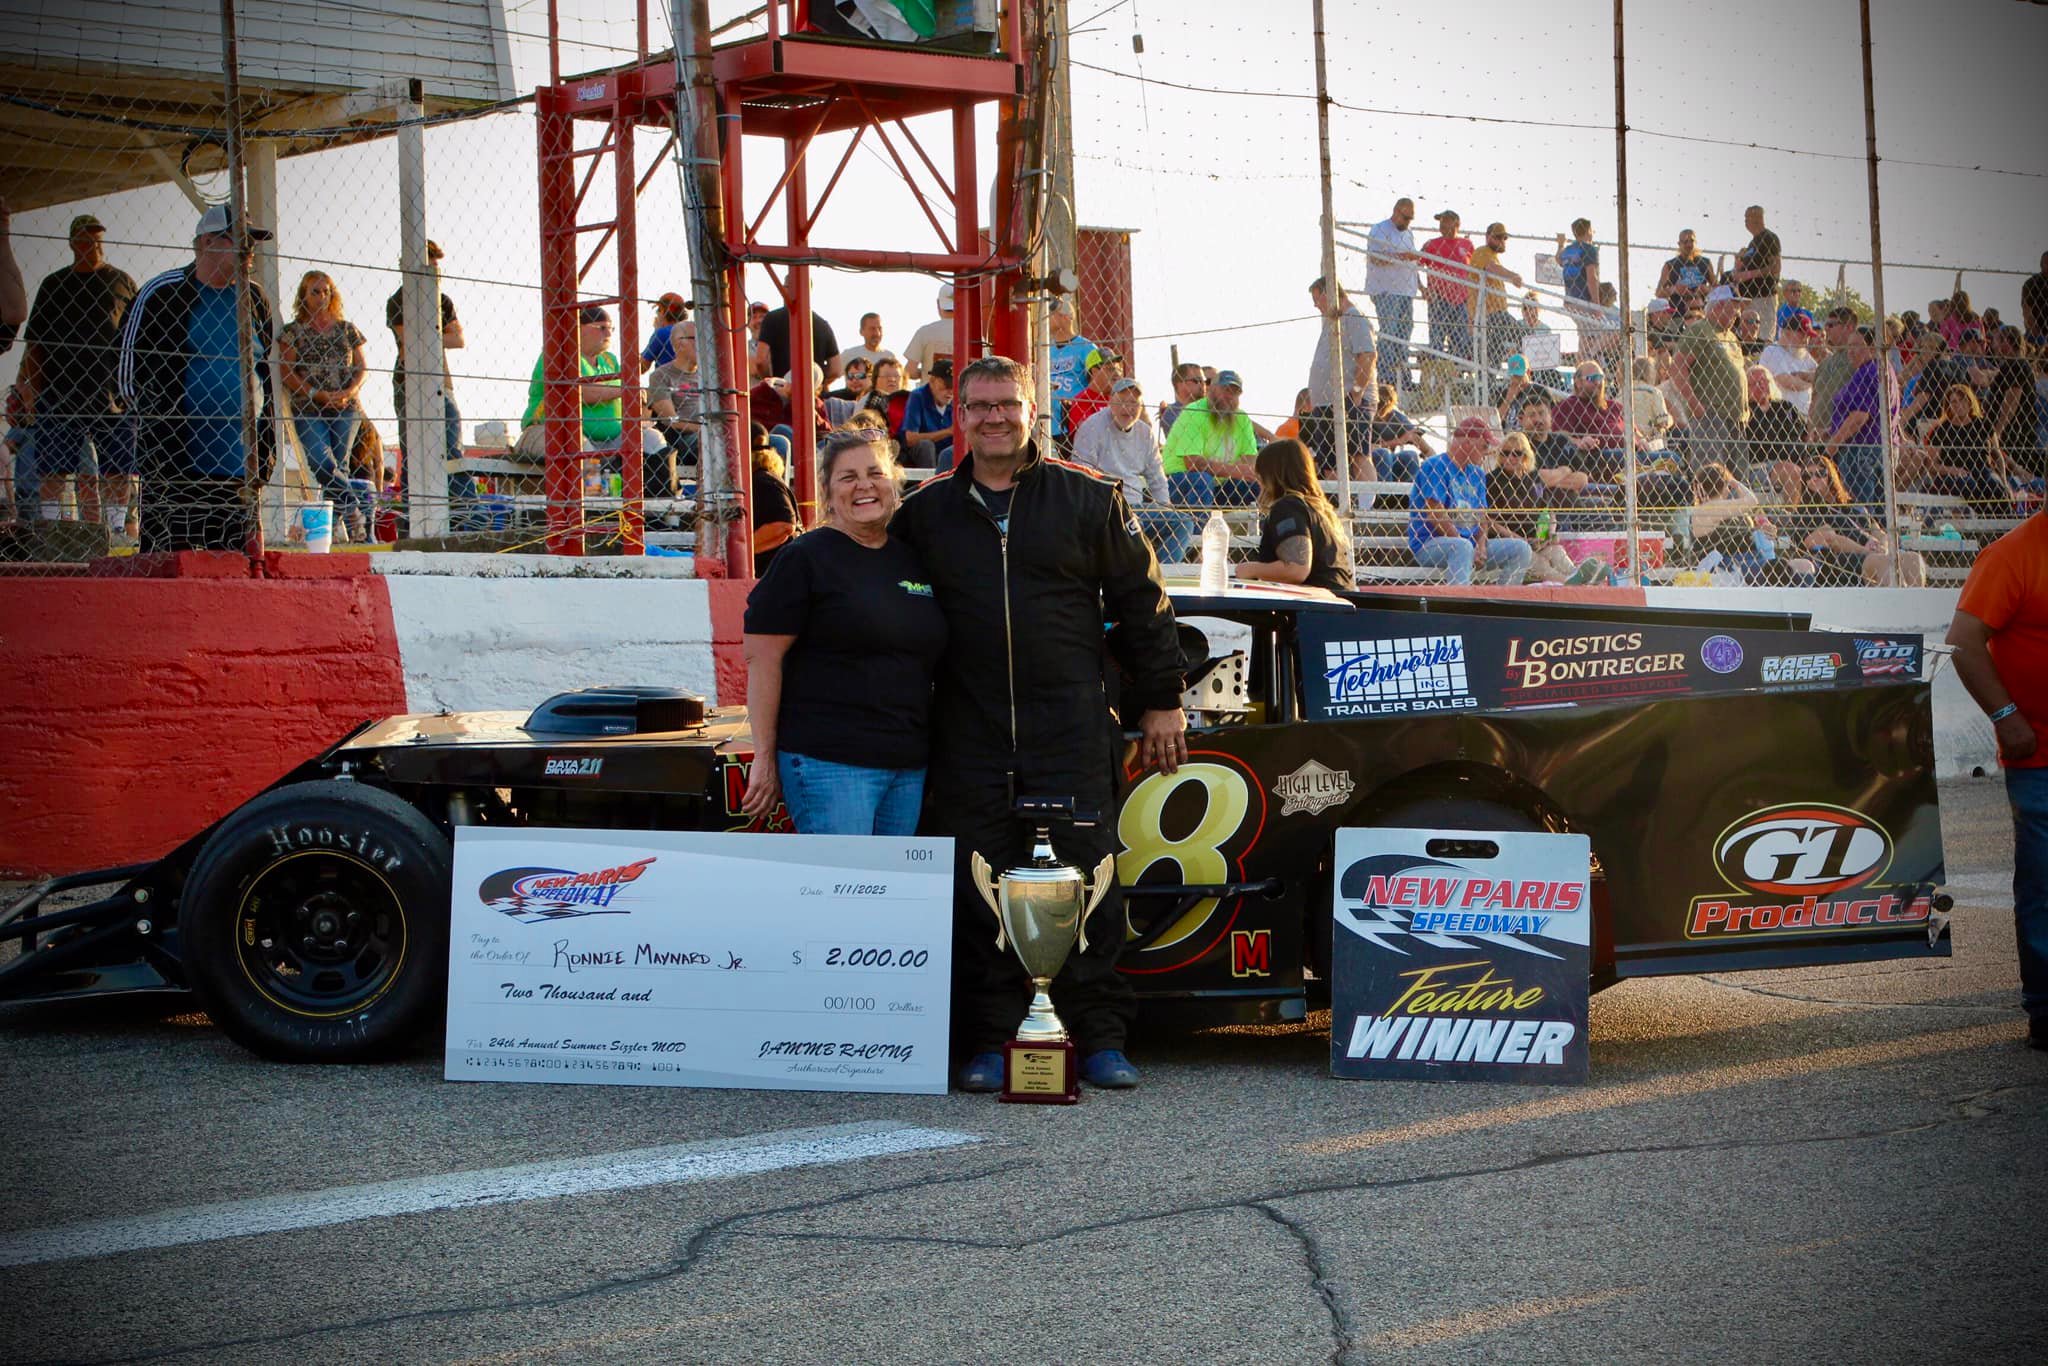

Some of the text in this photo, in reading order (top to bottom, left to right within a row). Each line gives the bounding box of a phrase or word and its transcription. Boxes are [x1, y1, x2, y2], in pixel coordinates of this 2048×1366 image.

[1507, 633, 1642, 667] LOGISTICS
[1323, 638, 1462, 701] Techworks
[1522, 653, 1685, 688] BONTREGER
[1764, 655, 1830, 670] RACE
[1420, 679, 1449, 689] INC.
[1762, 668, 1835, 681] WRAPS
[1323, 697, 1478, 717] TRAILER SALES
[547, 759, 578, 768] DATA
[1280, 772, 1351, 794] HIGH LEVEL
[268, 822, 401, 872] Hoosier
[905, 850, 933, 860] 1001
[1116, 763, 1249, 952] 8
[1722, 826, 1858, 881] G1
[531, 884, 620, 907] SPEEDWAY
[833, 884, 887, 896] 8/1/2025
[1363, 875, 1585, 911] NEW PARIS
[1410, 912, 1549, 933] SPEEDWAY
[1692, 896, 1930, 933] Products
[553, 939, 625, 973] RONNIE
[634, 943, 711, 966] MAYNARD
[792, 951, 802, 965] $
[1231, 930, 1271, 977] M
[500, 983, 653, 1001] Two Thousand and
[1382, 960, 1544, 1021] Feature
[824, 996, 875, 1011] 00/100
[489, 1037, 516, 1048] 24th
[517, 1038, 560, 1049] Annual
[561, 1039, 607, 1050] Summer
[610, 1040, 648, 1054] Sizzler
[651, 1041, 687, 1053] MOD
[1346, 1015, 1576, 1065] WINNER
[758, 1041, 914, 1062] JAMMB RACING
[787, 1063, 885, 1077] Authorized Signature
